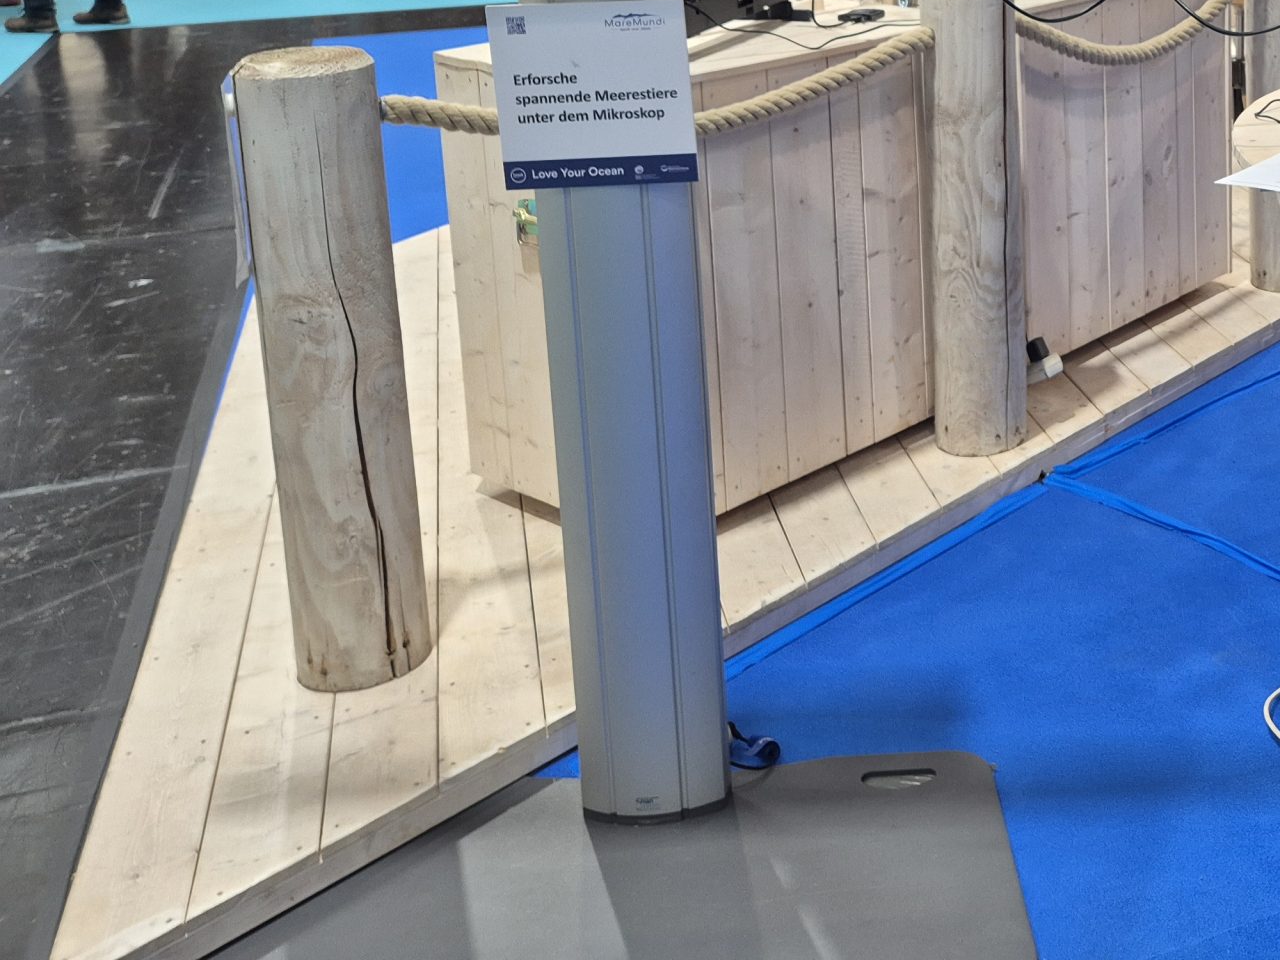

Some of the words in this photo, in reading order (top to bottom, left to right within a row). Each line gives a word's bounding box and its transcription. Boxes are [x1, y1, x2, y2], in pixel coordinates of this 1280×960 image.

[604, 17, 666, 29] MareMundi
[513, 72, 578, 86] Erforsche
[515, 90, 591, 108] spannende
[595, 87, 678, 102] Meerestiere
[517, 112, 555, 124] unter
[558, 110, 589, 123] dem
[593, 107, 665, 121] Mikroskop
[531, 167, 558, 180] Love
[560, 166, 586, 179] Your
[588, 164, 625, 177] Ocean
